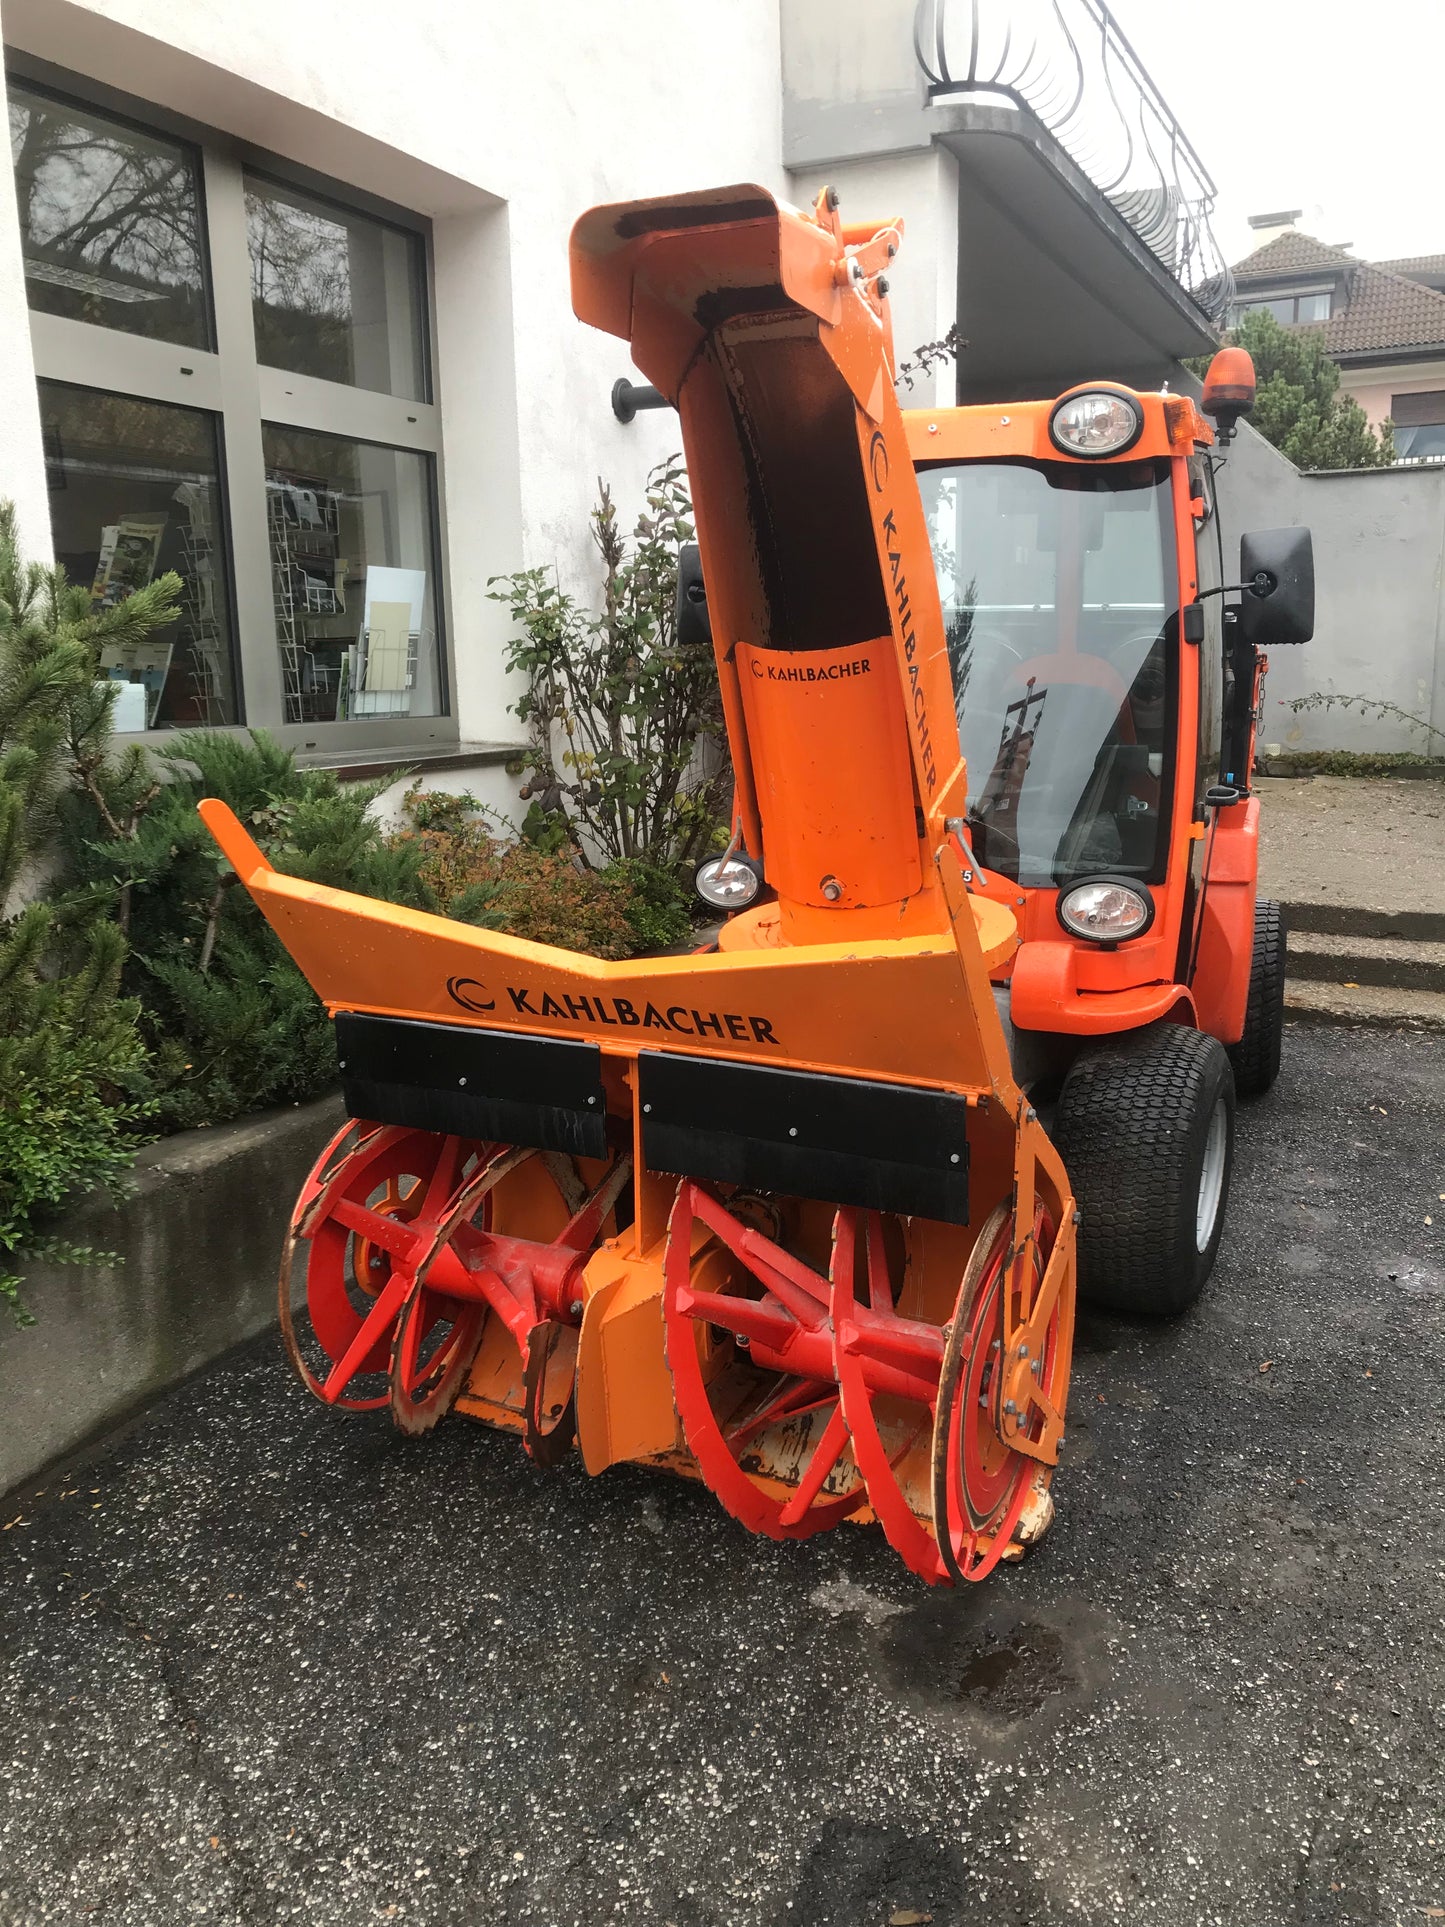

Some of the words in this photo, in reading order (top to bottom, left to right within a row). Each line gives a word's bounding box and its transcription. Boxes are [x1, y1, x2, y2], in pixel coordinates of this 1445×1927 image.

[768, 659, 871, 683] KAHLBACHER
[883, 509, 937, 796] KAHLBACHER
[507, 987, 780, 1045] KAHLBACHER
